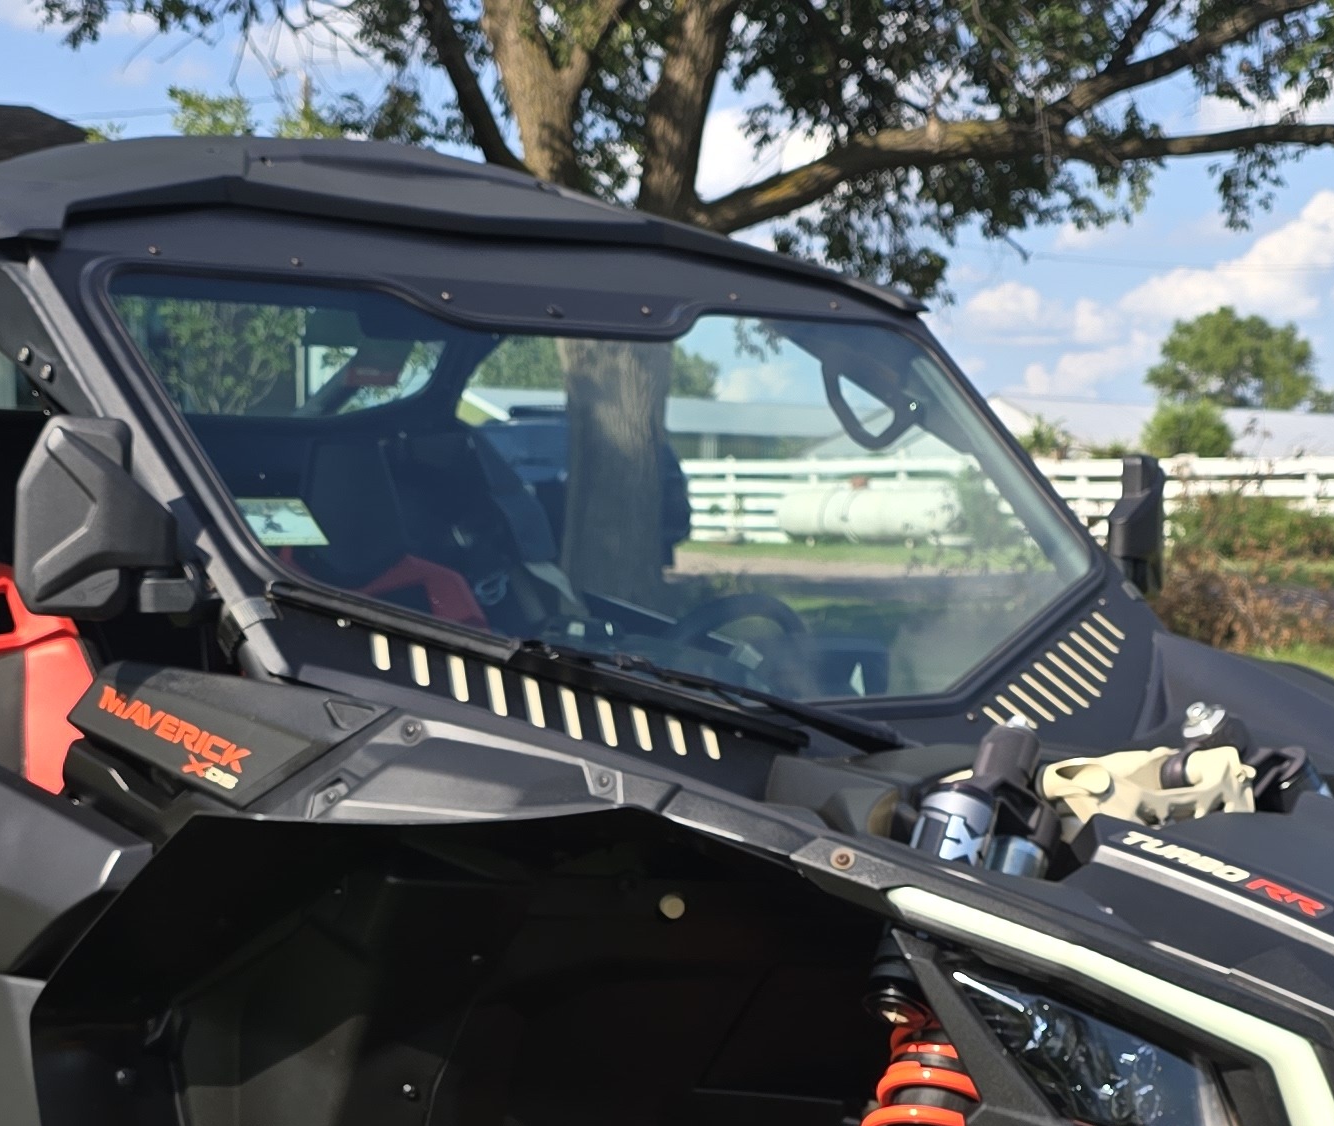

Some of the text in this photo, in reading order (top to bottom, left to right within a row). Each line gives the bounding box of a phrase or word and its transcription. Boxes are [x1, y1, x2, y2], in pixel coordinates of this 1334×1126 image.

[98, 685, 252, 773] MAVERICK
[1122, 830, 1326, 918] TURBO RR
